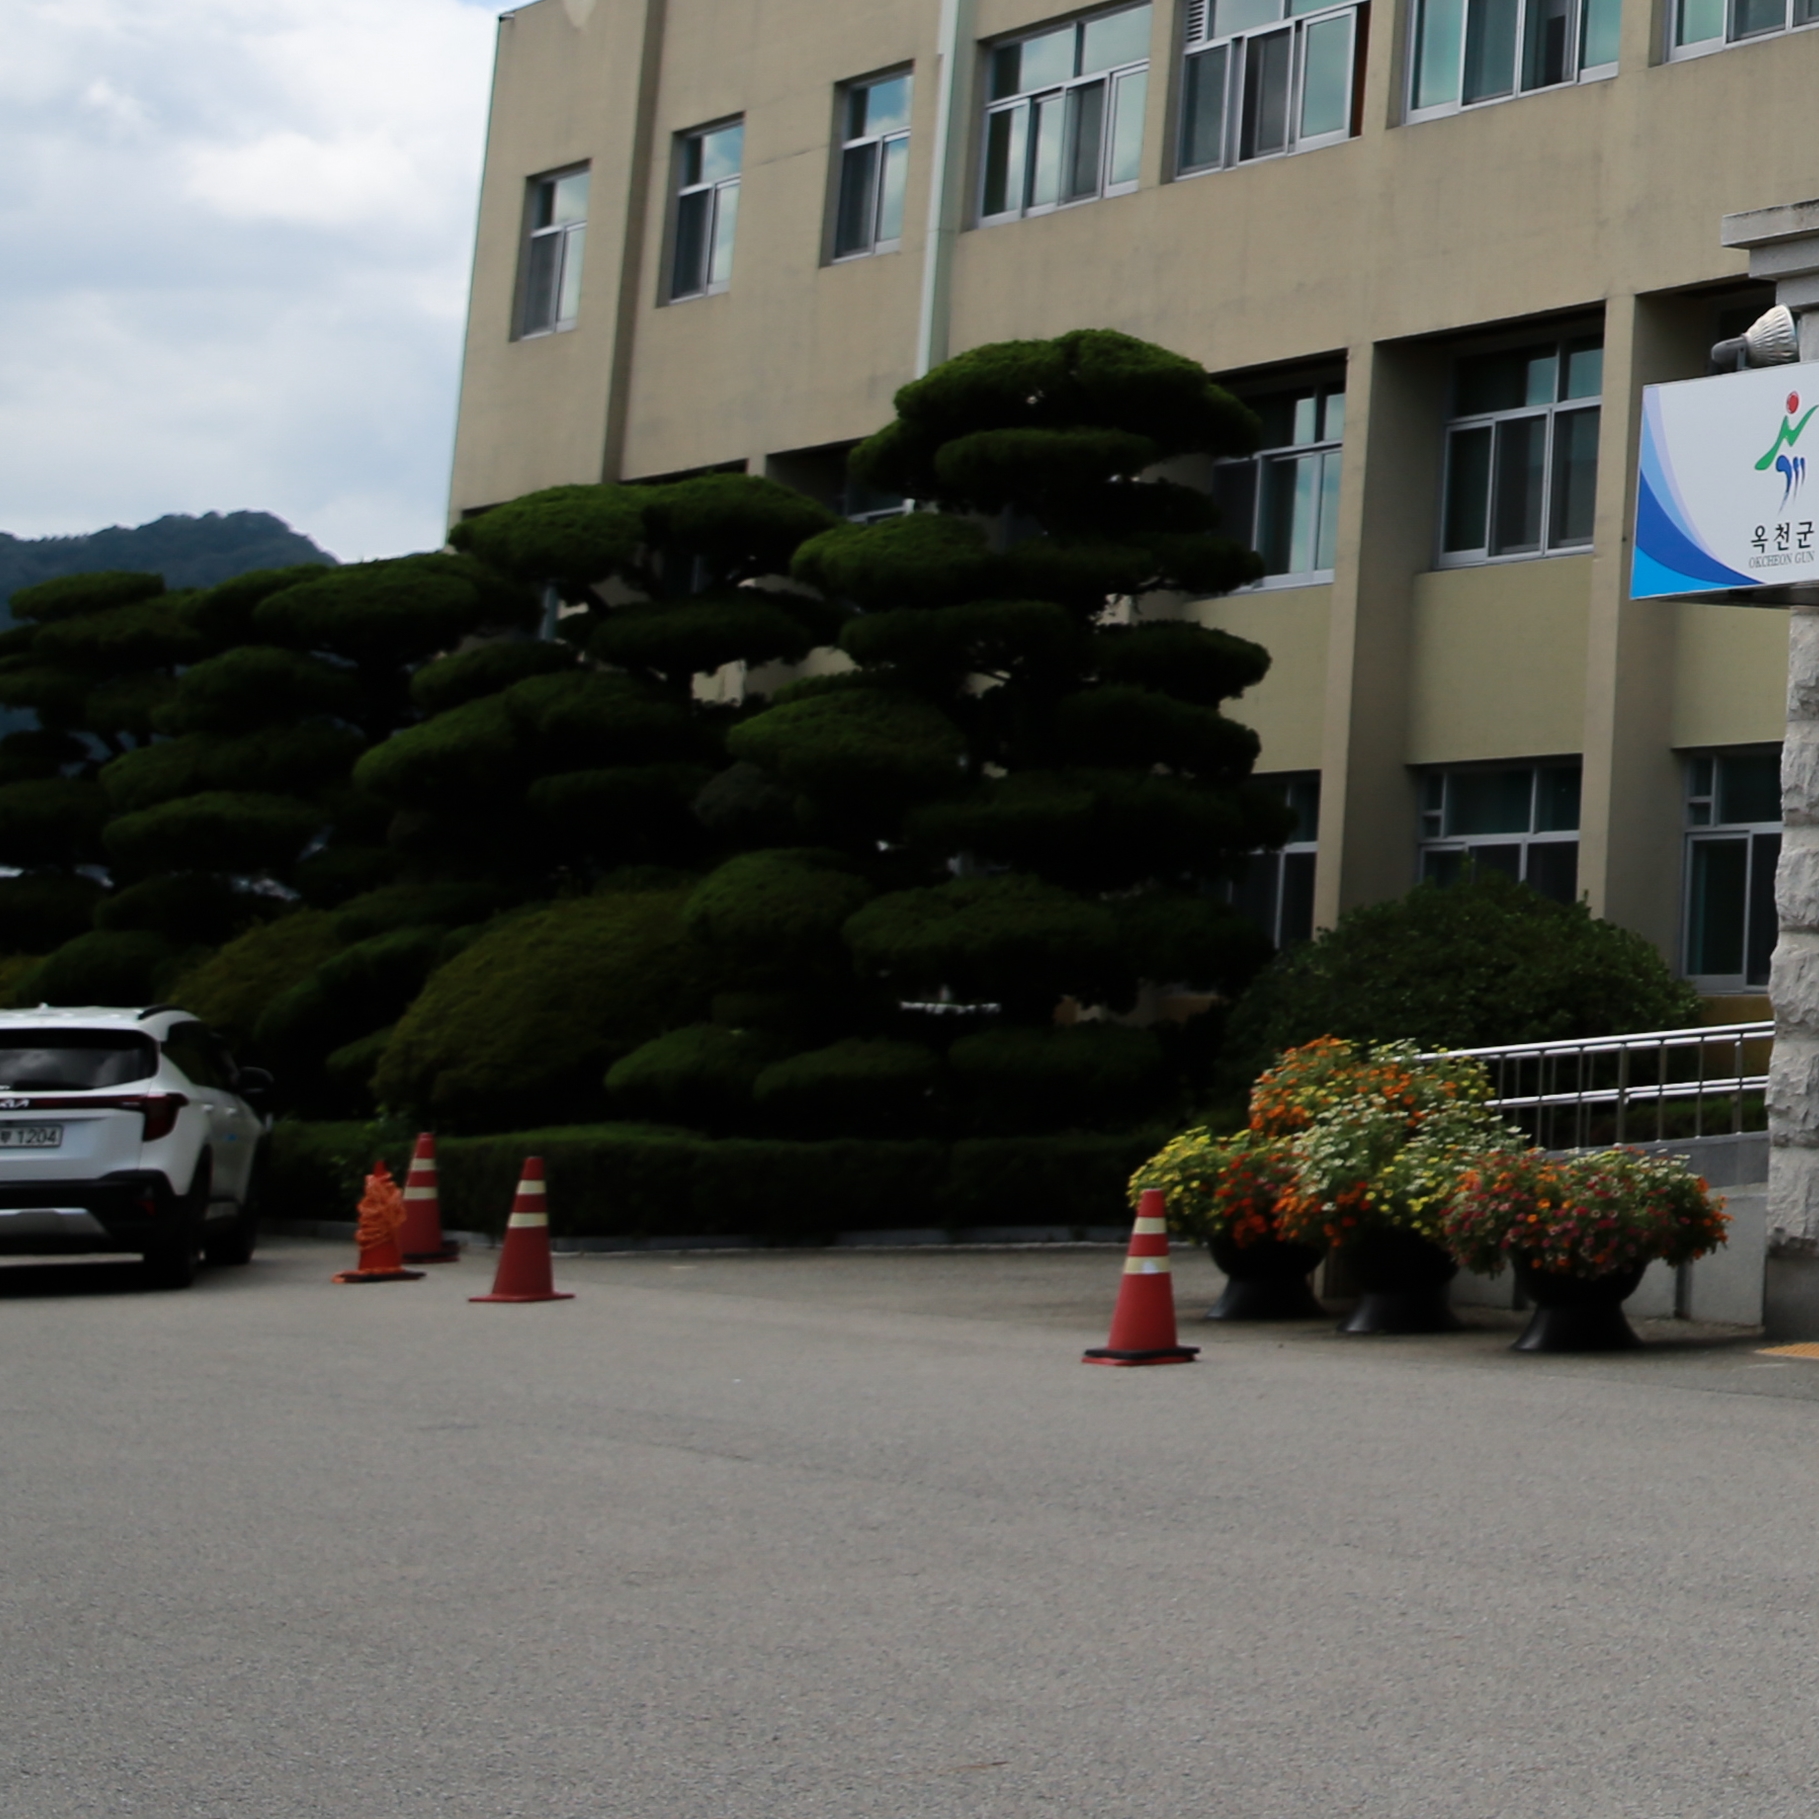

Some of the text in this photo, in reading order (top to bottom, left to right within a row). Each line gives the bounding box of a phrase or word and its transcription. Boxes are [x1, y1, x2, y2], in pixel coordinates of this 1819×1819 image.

[1750, 520, 1815, 554] 옥천군
[1749, 551, 1815, 568] OKCHEON GUN
[18, 1128, 57, 1144] 1204
